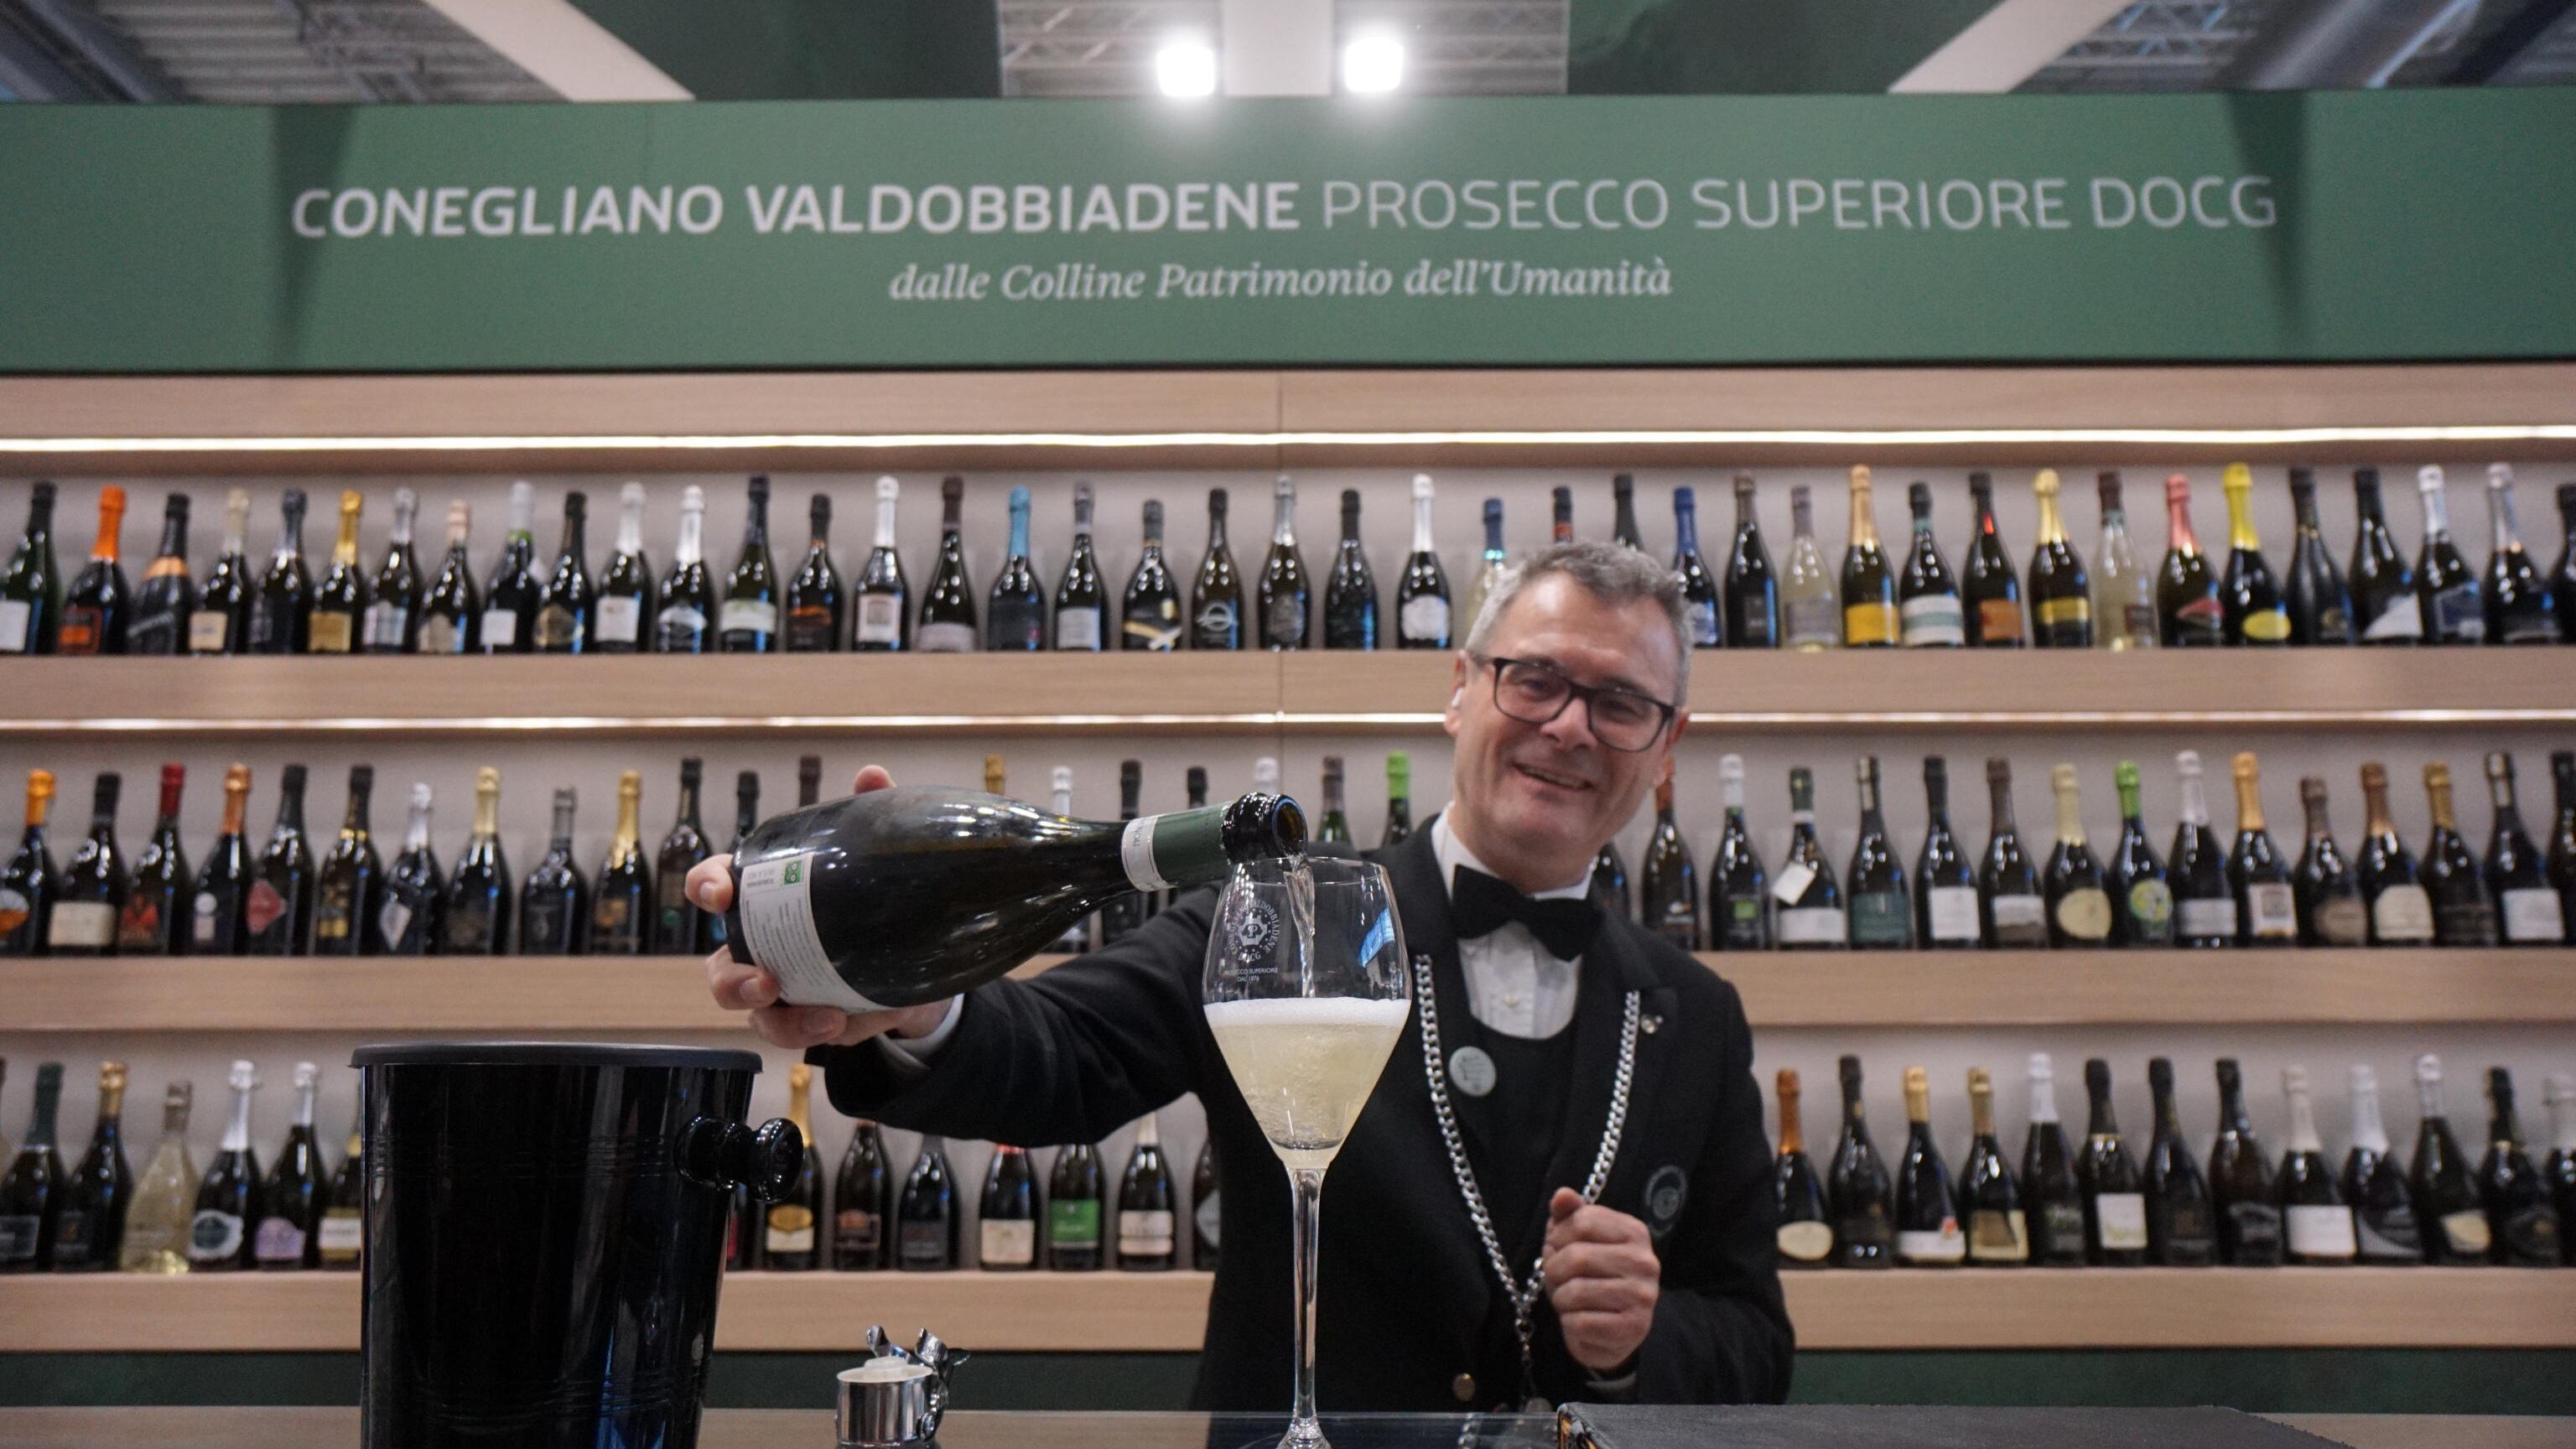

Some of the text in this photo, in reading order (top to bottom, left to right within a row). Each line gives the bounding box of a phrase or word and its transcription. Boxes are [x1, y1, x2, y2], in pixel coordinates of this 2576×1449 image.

[292, 176, 2277, 239] CONEGLIANO VALDOBBIADENE PROSECCO SUPERIORE DOCG
[888, 262, 990, 301] dalle
[1001, 262, 1145, 300] Colline
[1156, 260, 1393, 299] Patrimonio
